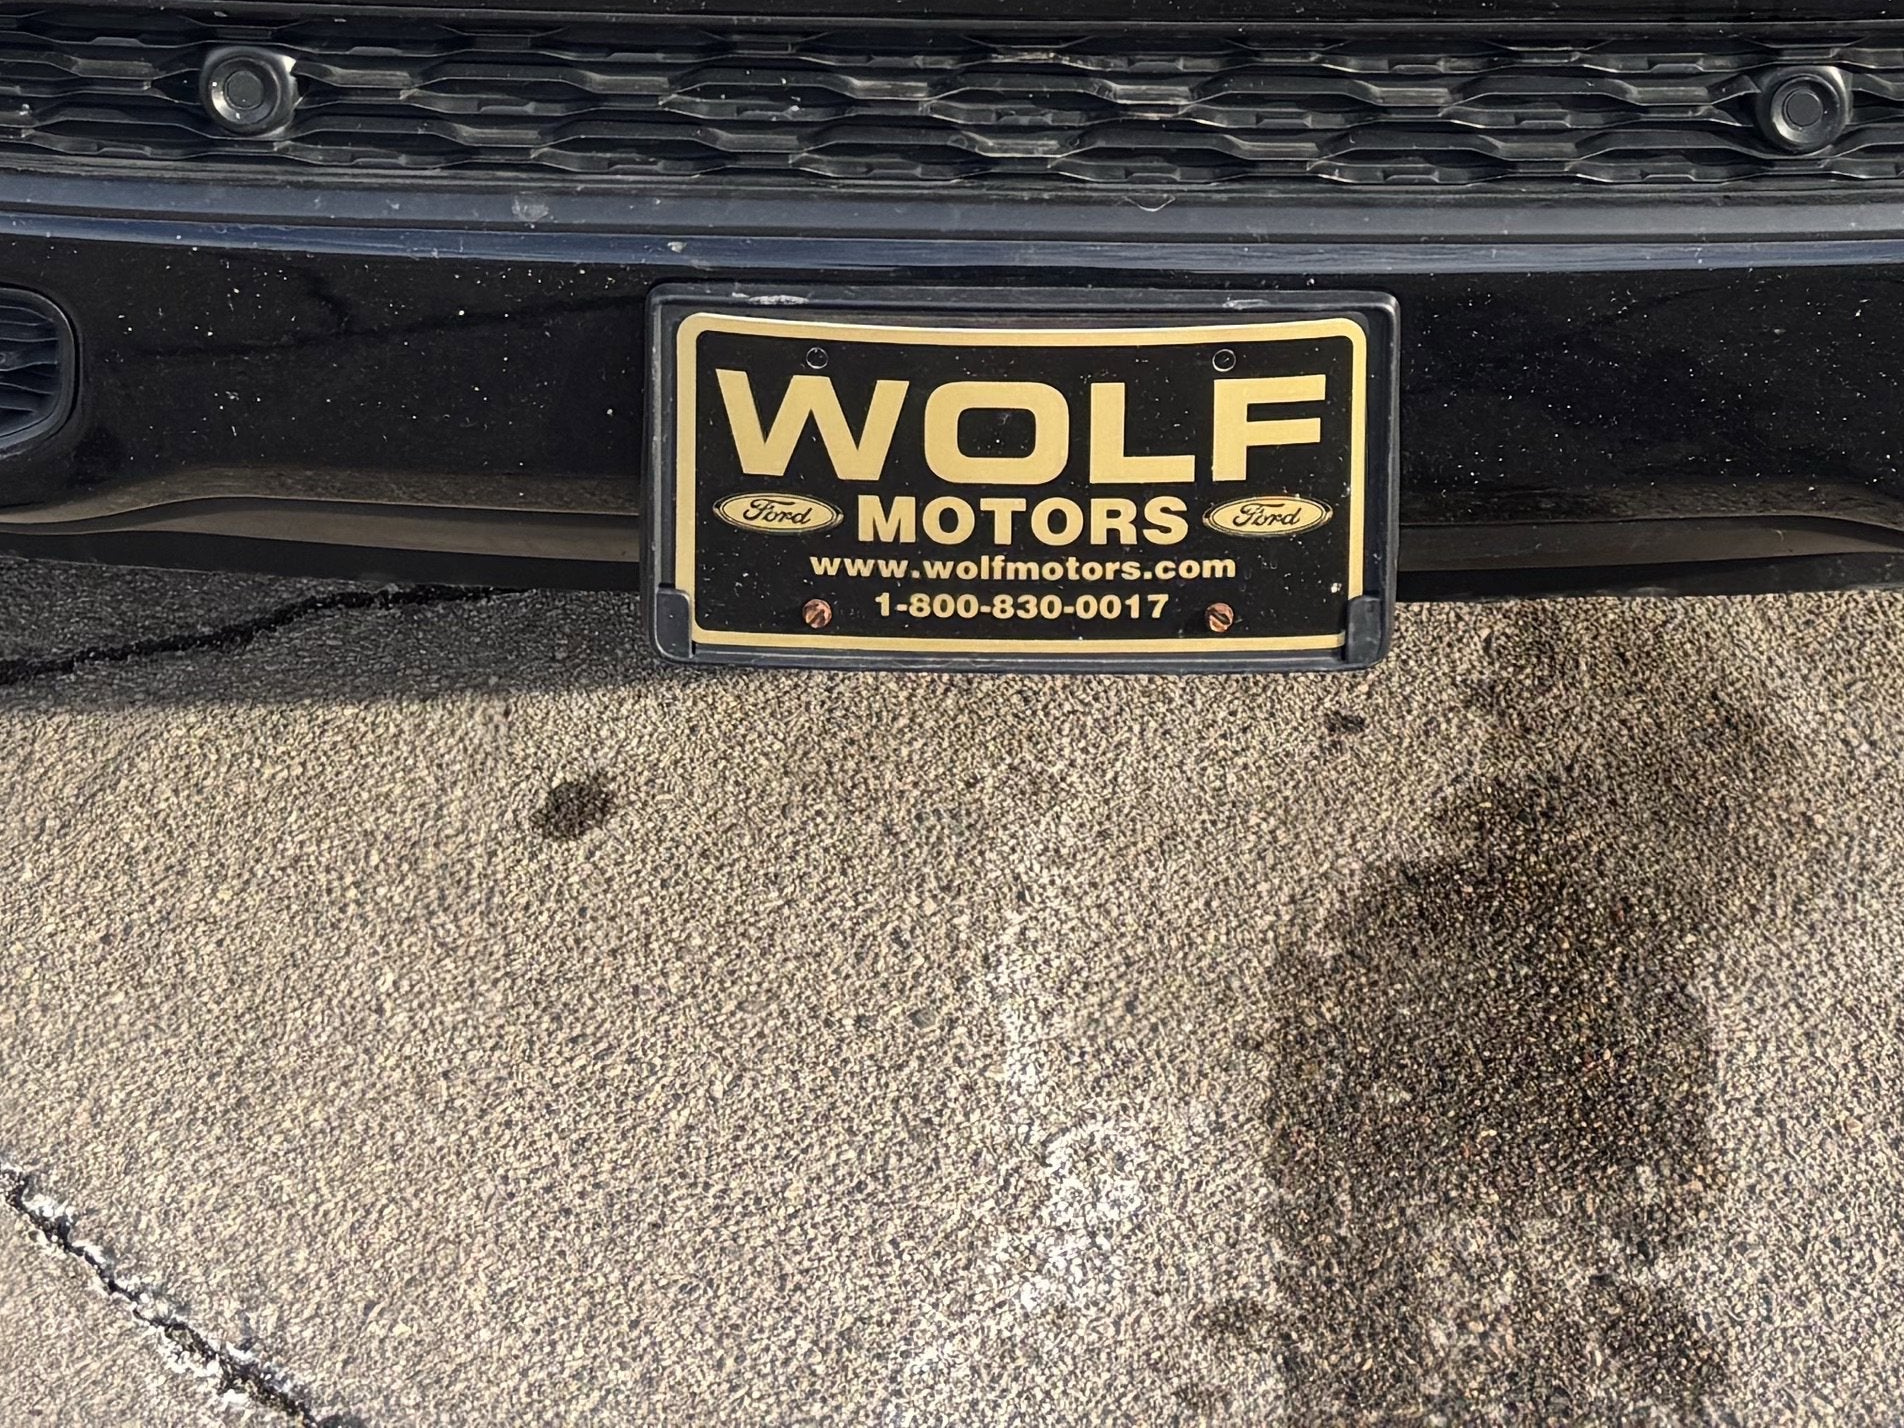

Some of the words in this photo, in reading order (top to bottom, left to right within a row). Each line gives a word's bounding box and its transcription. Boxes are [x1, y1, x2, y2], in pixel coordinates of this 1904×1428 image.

[714, 368, 1328, 486] WOLF
[857, 494, 1190, 547] MOTORS
[810, 553, 1237, 581] www.wolfmotors.com
[874, 592, 1170, 622] 1-800-830-0017
